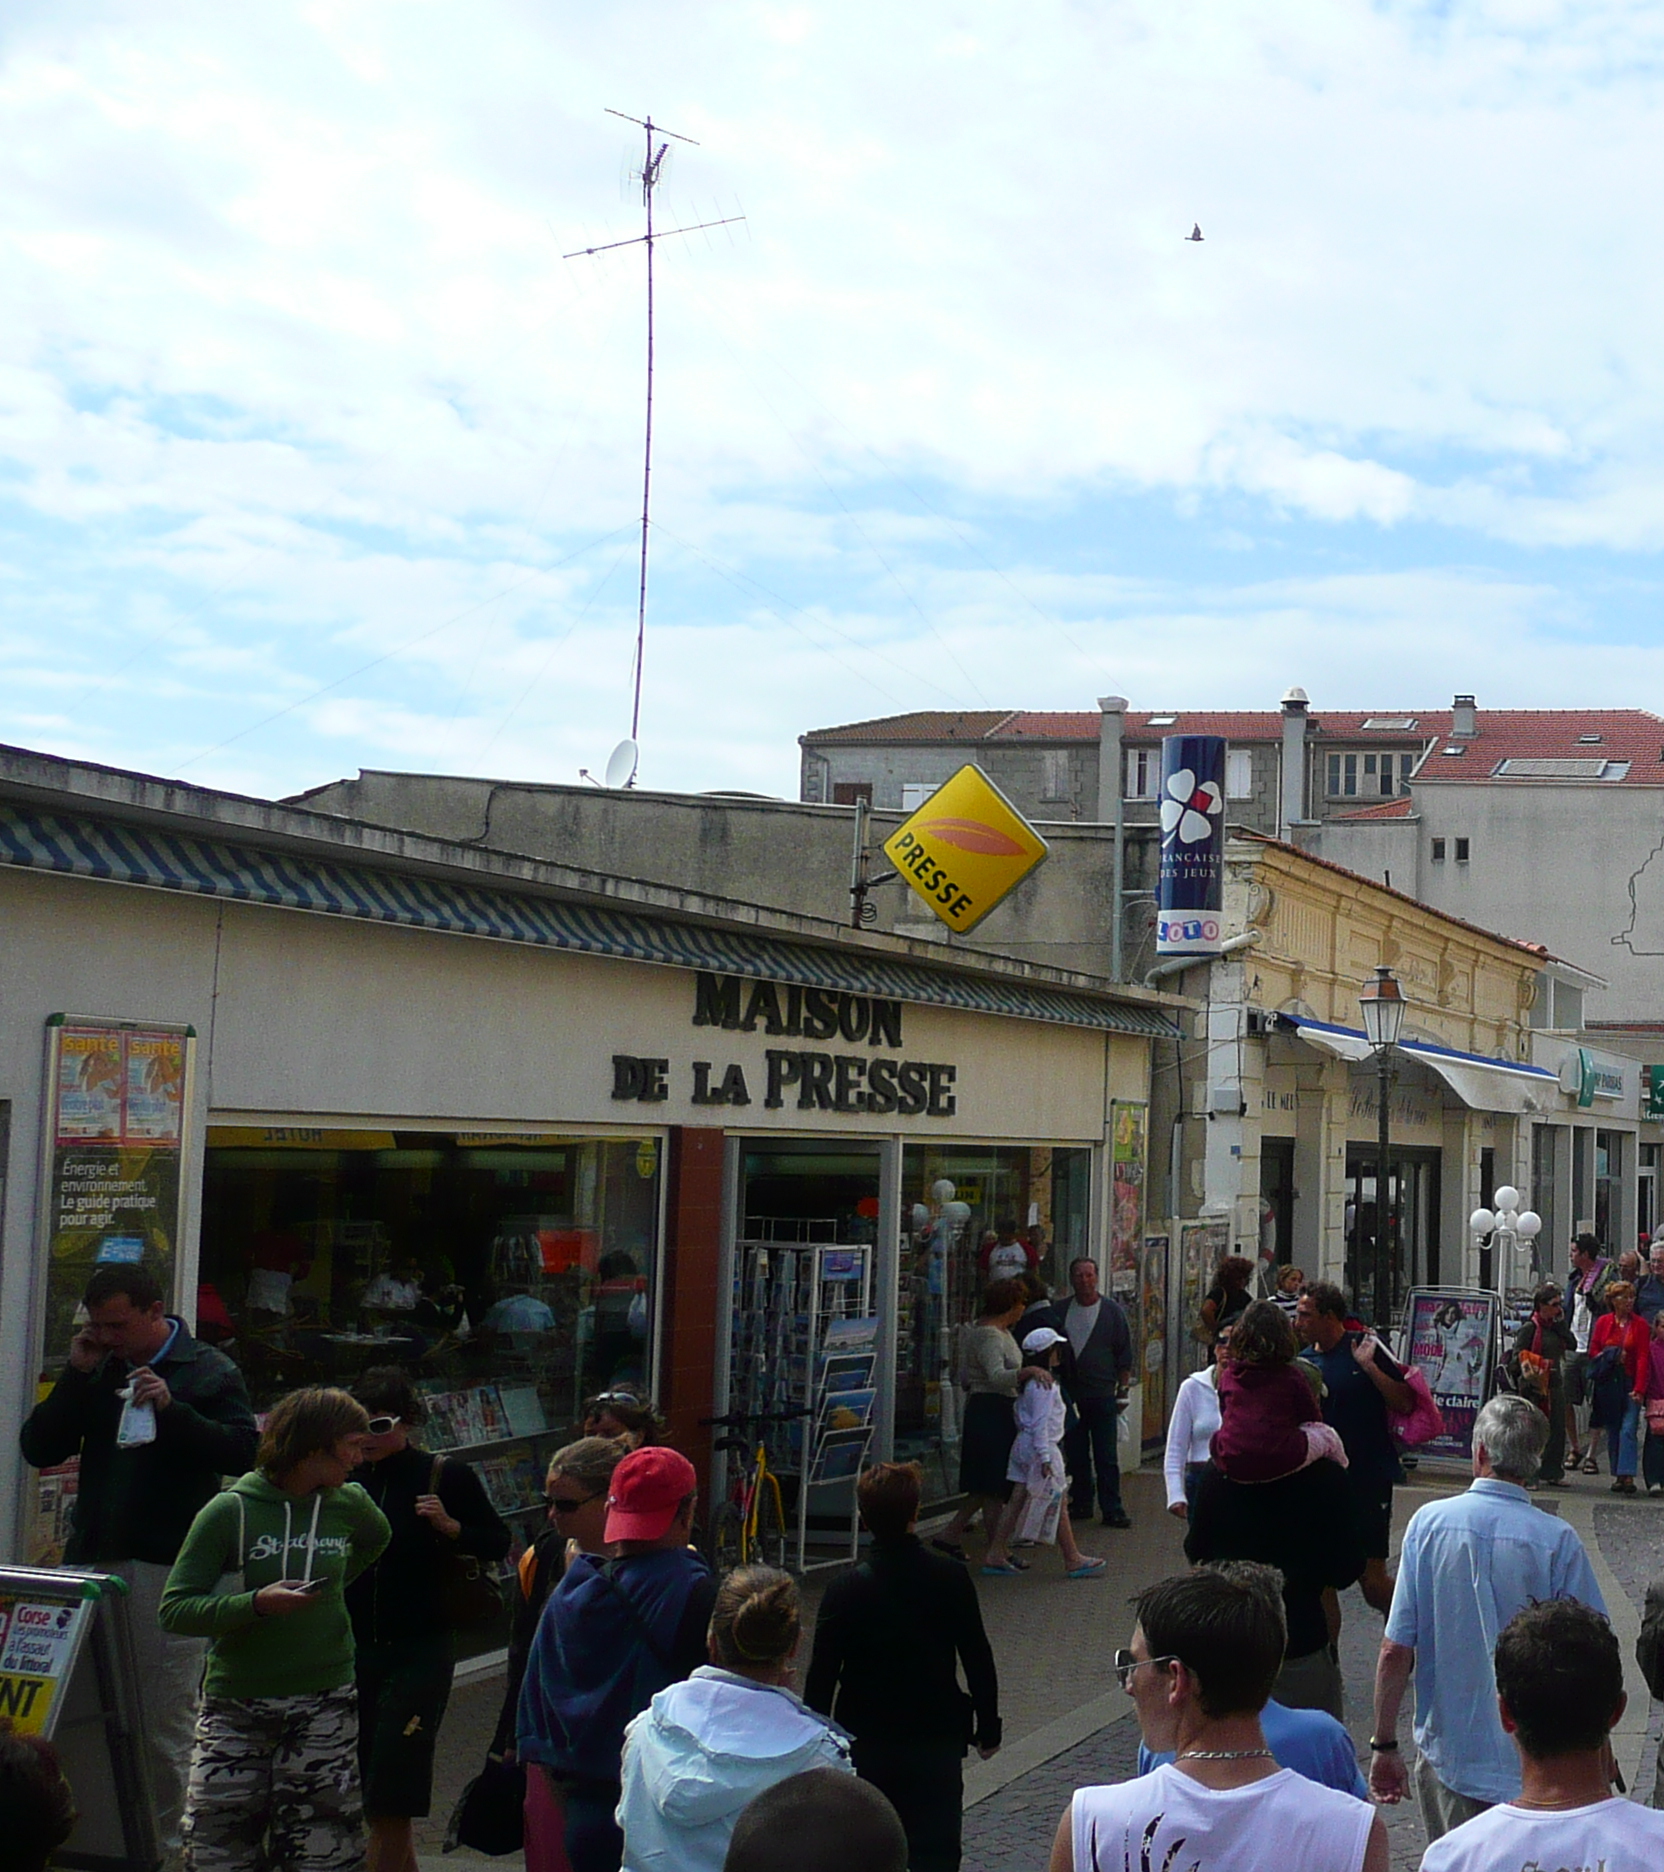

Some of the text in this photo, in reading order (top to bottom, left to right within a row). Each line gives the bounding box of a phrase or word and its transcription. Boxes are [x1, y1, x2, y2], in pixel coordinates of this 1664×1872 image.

[894, 832, 973, 918] PRESSE
[1183, 868, 1216, 879] JEUX
[1158, 919, 1220, 943] LOTO
[692, 971, 904, 1048] MAISON
[611, 1049, 957, 1117] DE LA PRESSE
[62, 1158, 119, 1178] Énergie et
[60, 1195, 156, 1212] Le guide pratique
[60, 1213, 87, 1228] pour
[1446, 1396, 1481, 1409] claire
[18, 1606, 52, 1626] Corse
[3, 1653, 54, 1674] du littoral
